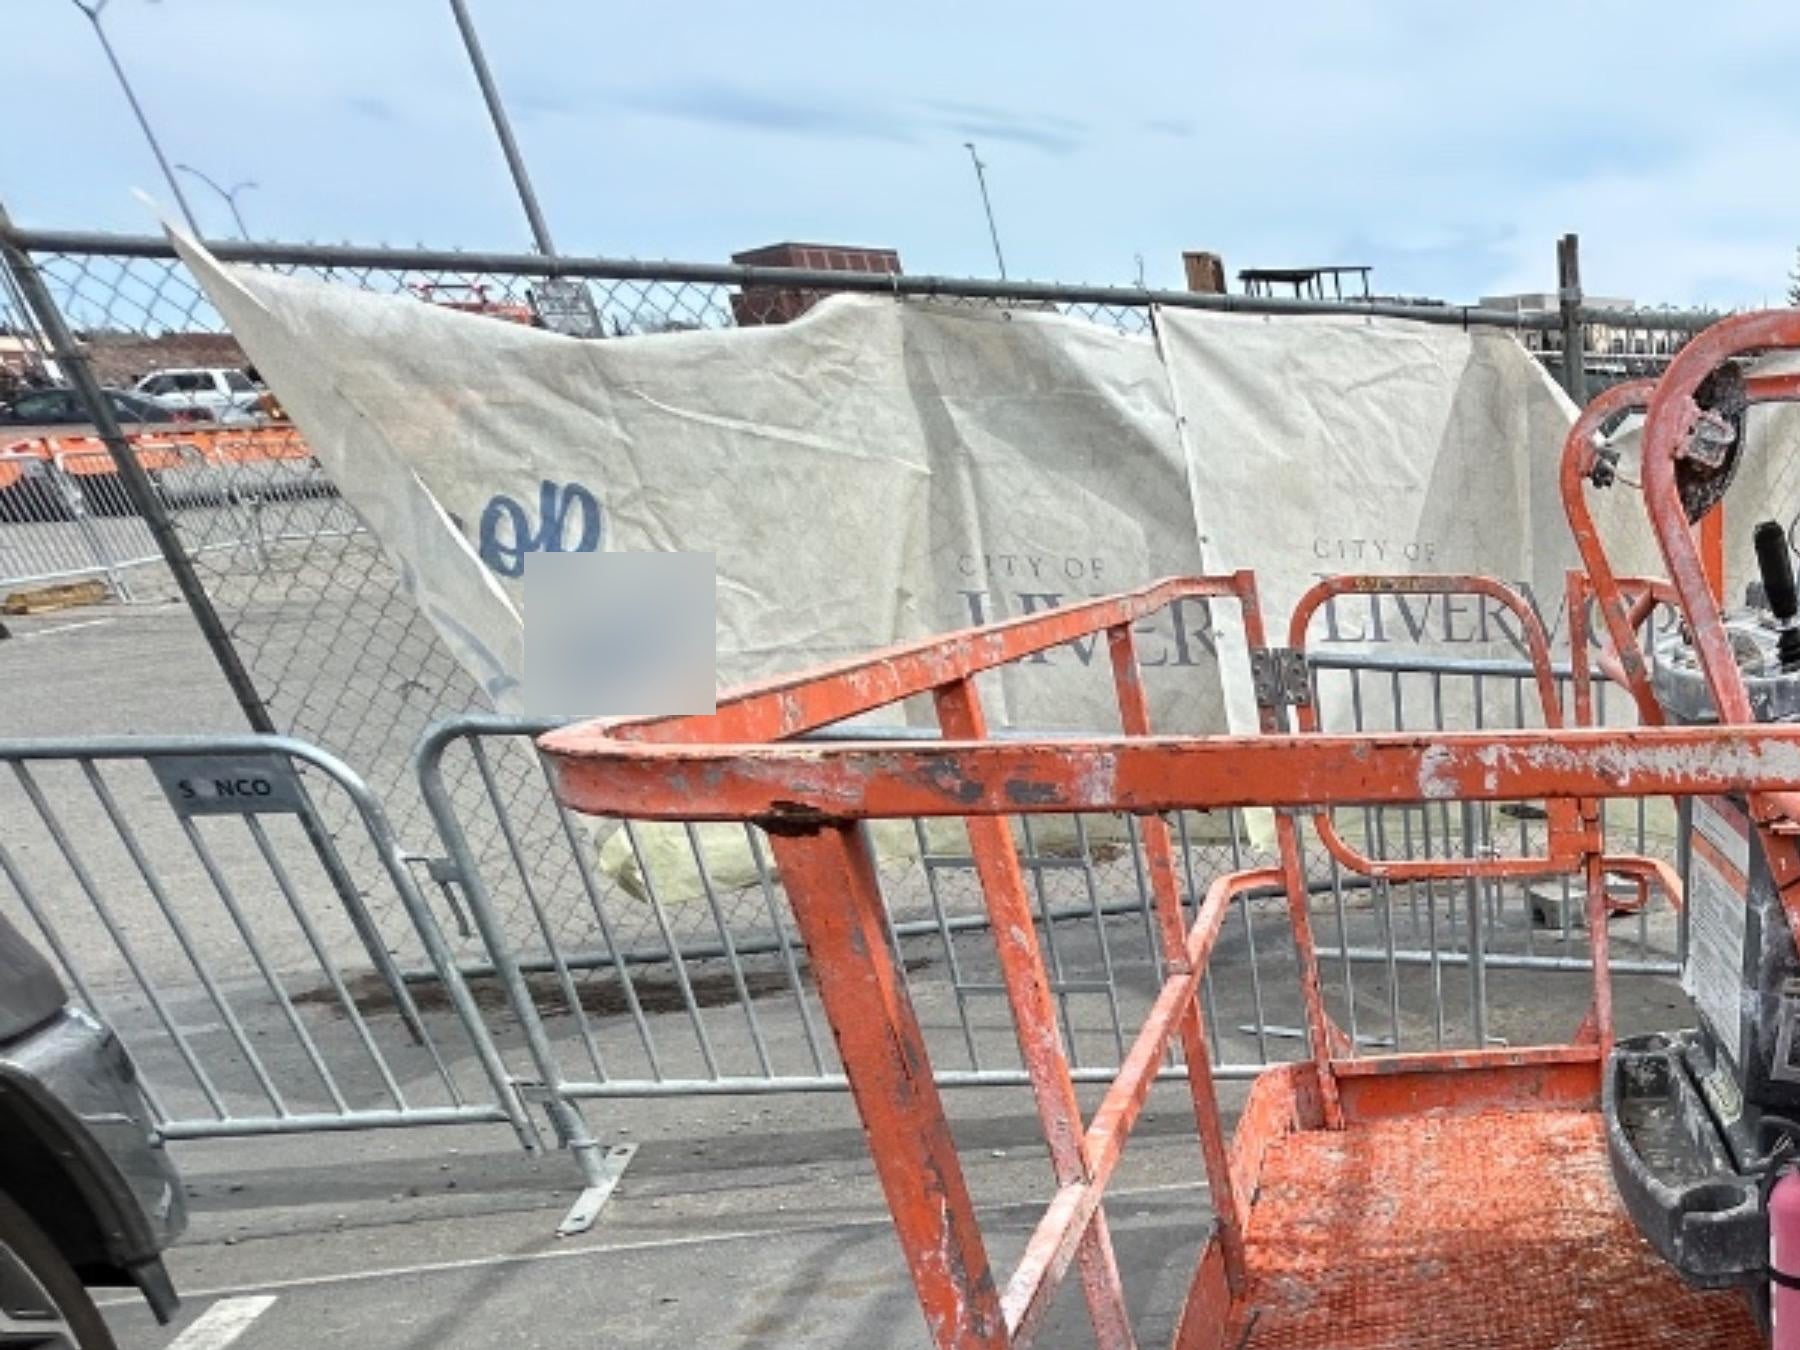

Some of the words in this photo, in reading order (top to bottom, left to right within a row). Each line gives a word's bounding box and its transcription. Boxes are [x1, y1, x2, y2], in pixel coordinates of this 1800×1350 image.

[1312, 538, 1390, 561] CITY
[957, 554, 1044, 578] CITY
[1063, 556, 1106, 580] OF
[177, 779, 272, 799] SNCO
